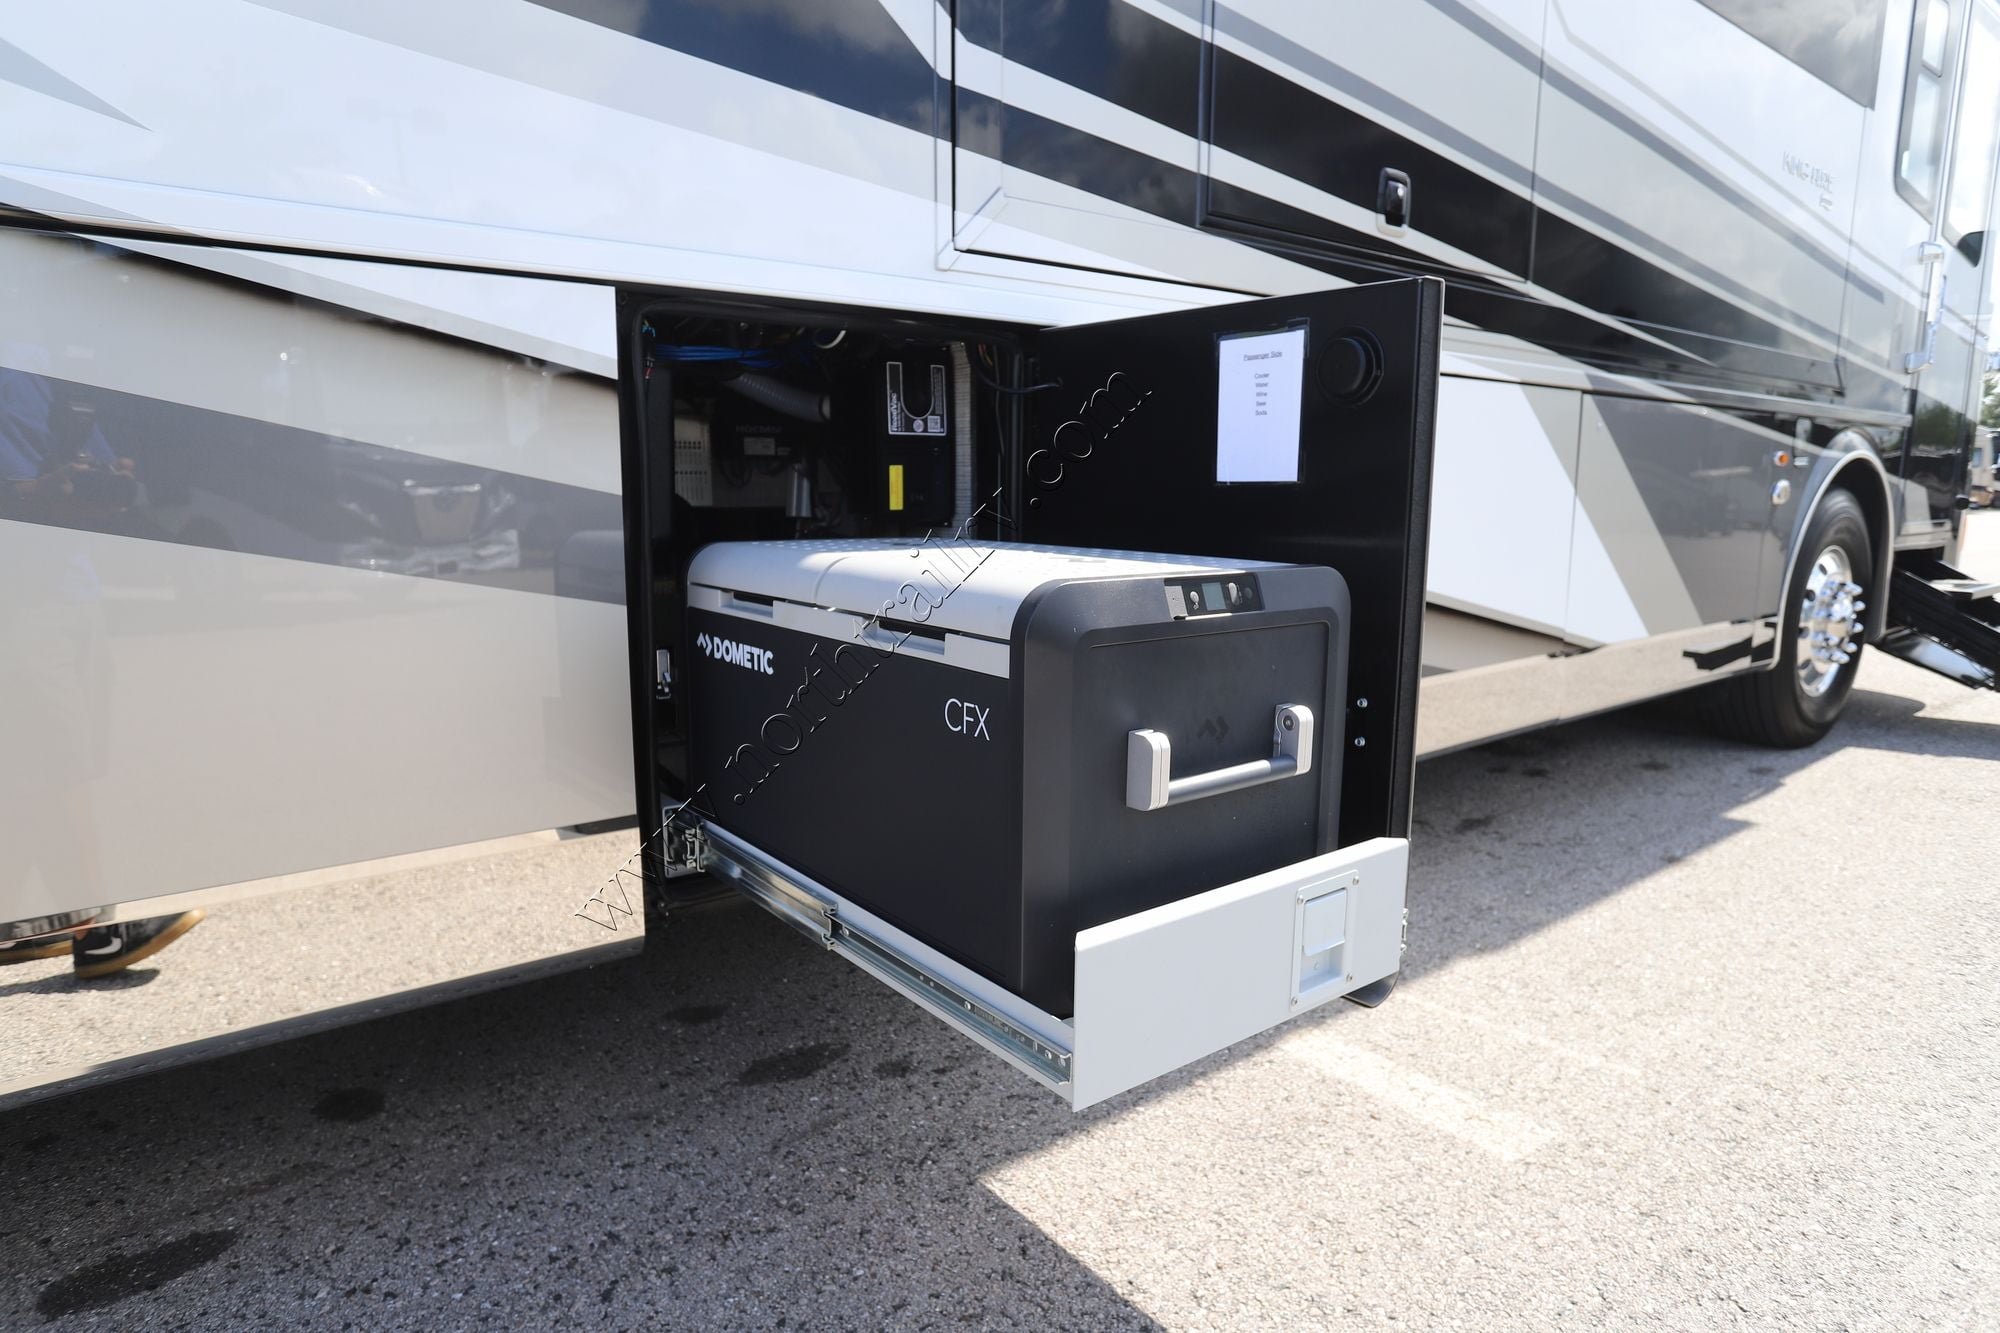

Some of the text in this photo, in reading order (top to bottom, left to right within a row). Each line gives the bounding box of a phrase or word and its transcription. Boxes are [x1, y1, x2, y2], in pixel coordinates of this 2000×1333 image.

[1244, 351, 1283, 362] Passenger Side
[713, 637, 774, 675] DOMETIC
[944, 698, 990, 742] CFX
